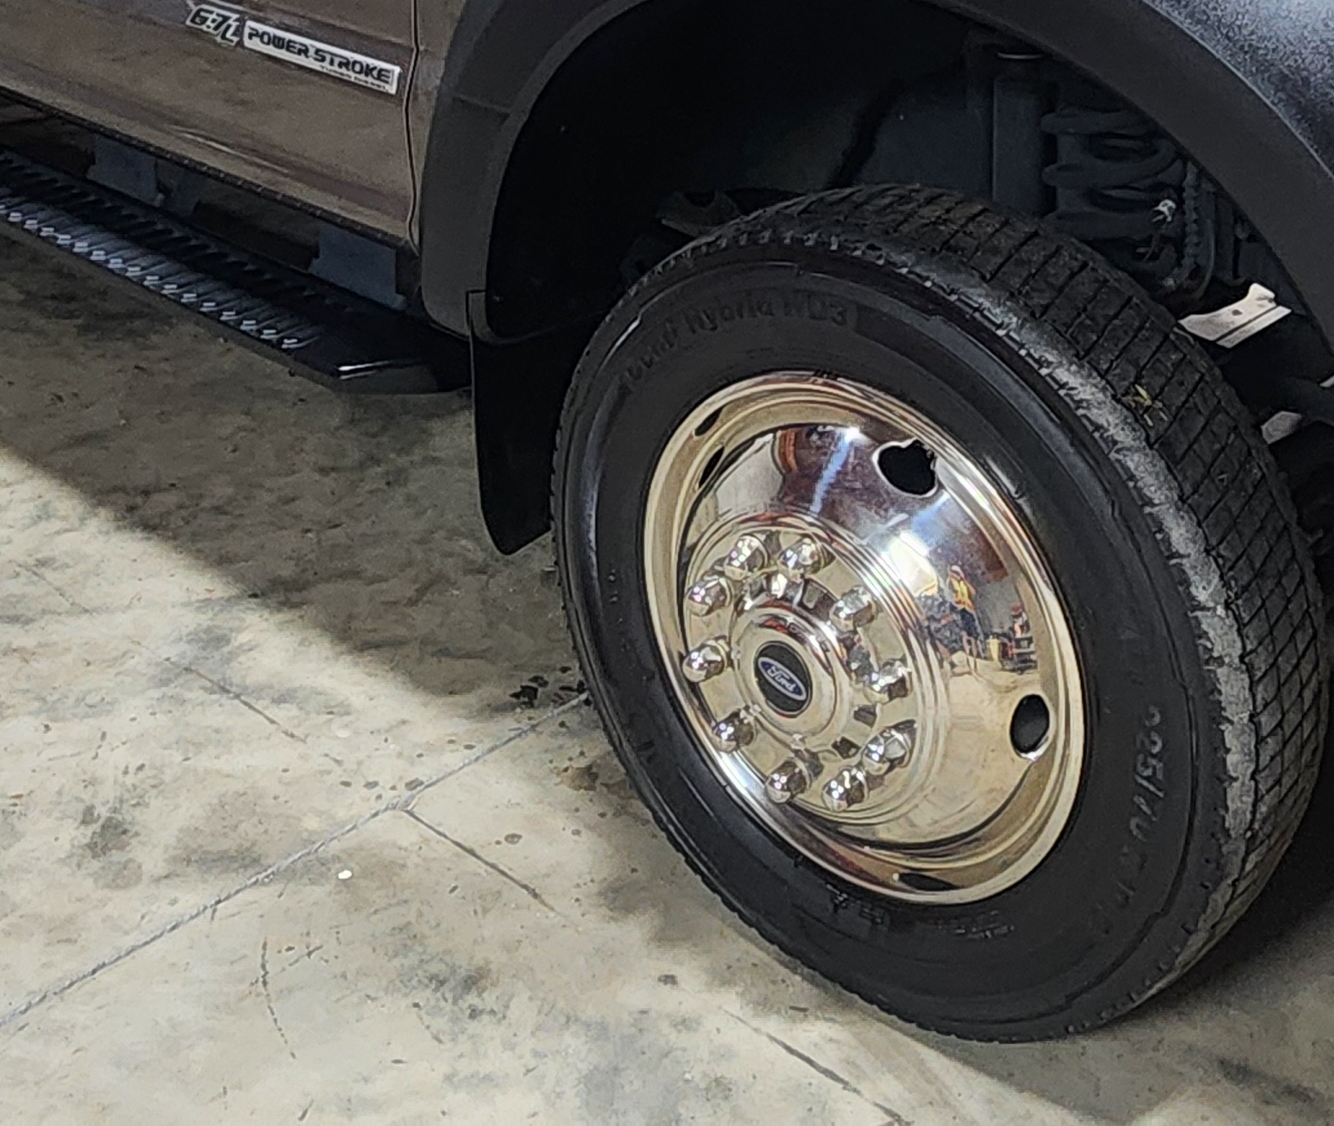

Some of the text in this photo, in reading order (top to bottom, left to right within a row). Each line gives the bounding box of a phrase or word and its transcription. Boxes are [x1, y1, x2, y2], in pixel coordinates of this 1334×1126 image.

[189, 5, 393, 85] 6.7L POWER STROKE
[766, 664, 798, 693] Ford
